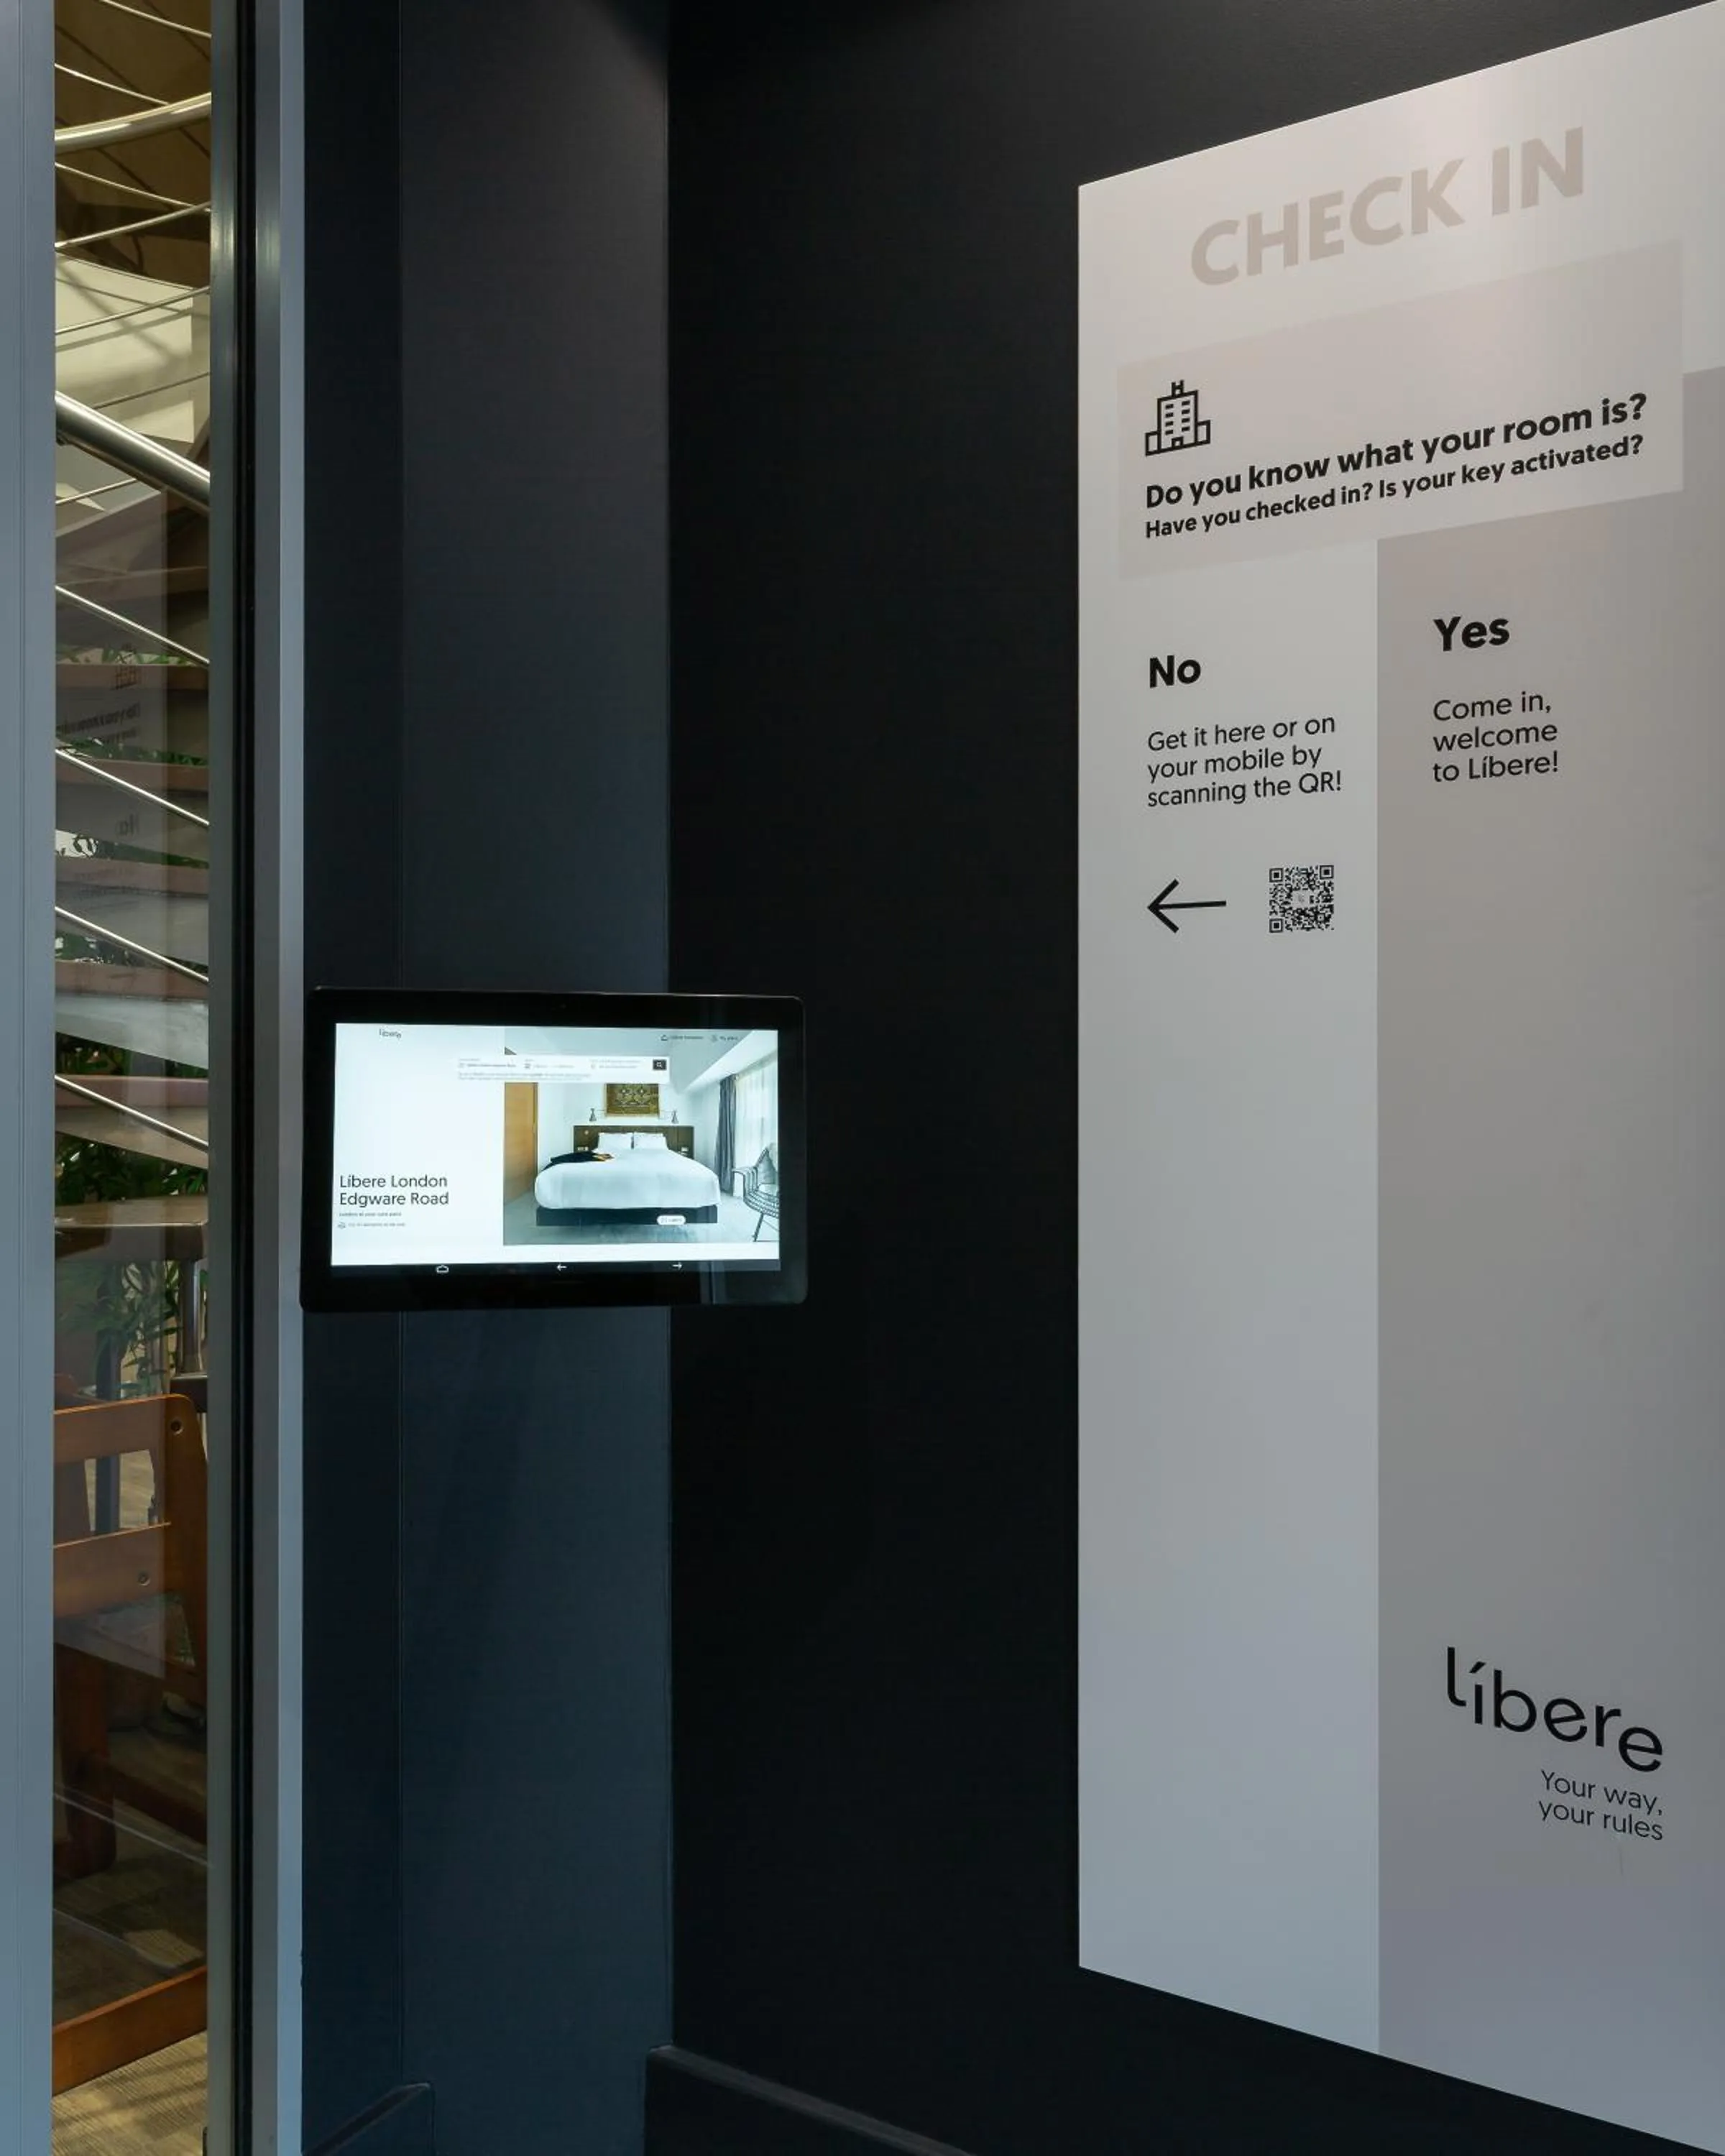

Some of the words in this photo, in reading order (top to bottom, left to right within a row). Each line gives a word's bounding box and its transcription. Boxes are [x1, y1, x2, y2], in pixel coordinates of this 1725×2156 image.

[1191, 160, 1464, 286] CHECK
[1492, 125, 1584, 216] IN
[1146, 484, 1183, 509] Do
[1190, 474, 1241, 506] you
[1248, 457, 1330, 490] know
[1337, 439, 1414, 473] what
[1421, 426, 1496, 464] your
[1504, 409, 1592, 443] room
[1601, 392, 1647, 426] is?
[1146, 517, 1197, 538] Have
[1201, 510, 1241, 533] you
[1246, 488, 1335, 521] checked
[1341, 482, 1374, 505] in?
[1379, 479, 1397, 498] Is
[1402, 471, 1455, 498] your
[1461, 462, 1505, 484] key
[1510, 433, 1644, 476] activated?
[1433, 616, 1510, 652] Yes
[1149, 655, 1201, 688] No
[1433, 698, 1512, 722] Come
[1522, 691, 1551, 714] in,
[1148, 731, 1187, 751] Get
[1194, 727, 1208, 747] it
[1215, 724, 1266, 745] here
[1272, 721, 1297, 738] or
[1305, 717, 1335, 735] on
[1432, 724, 1558, 752] welcome
[1148, 760, 1198, 784] your
[1205, 747, 1284, 774] mobile
[1292, 745, 1322, 768] by
[1432, 763, 1460, 783] to
[1468, 750, 1558, 780] Líbere!
[1148, 781, 1246, 807] scanning
[1253, 776, 1292, 798] the
[1299, 770, 1341, 794] QR!
[391, 1174, 448, 1188] London
[340, 1192, 406, 1207] Edgware
[410, 1192, 449, 1205] Road
[1447, 1646, 1662, 1772] líbere
[1541, 1770, 1596, 1799] Your
[1604, 1787, 1662, 1816] way,
[1538, 1800, 1595, 1826] your
[1604, 1813, 1663, 1841] rules
